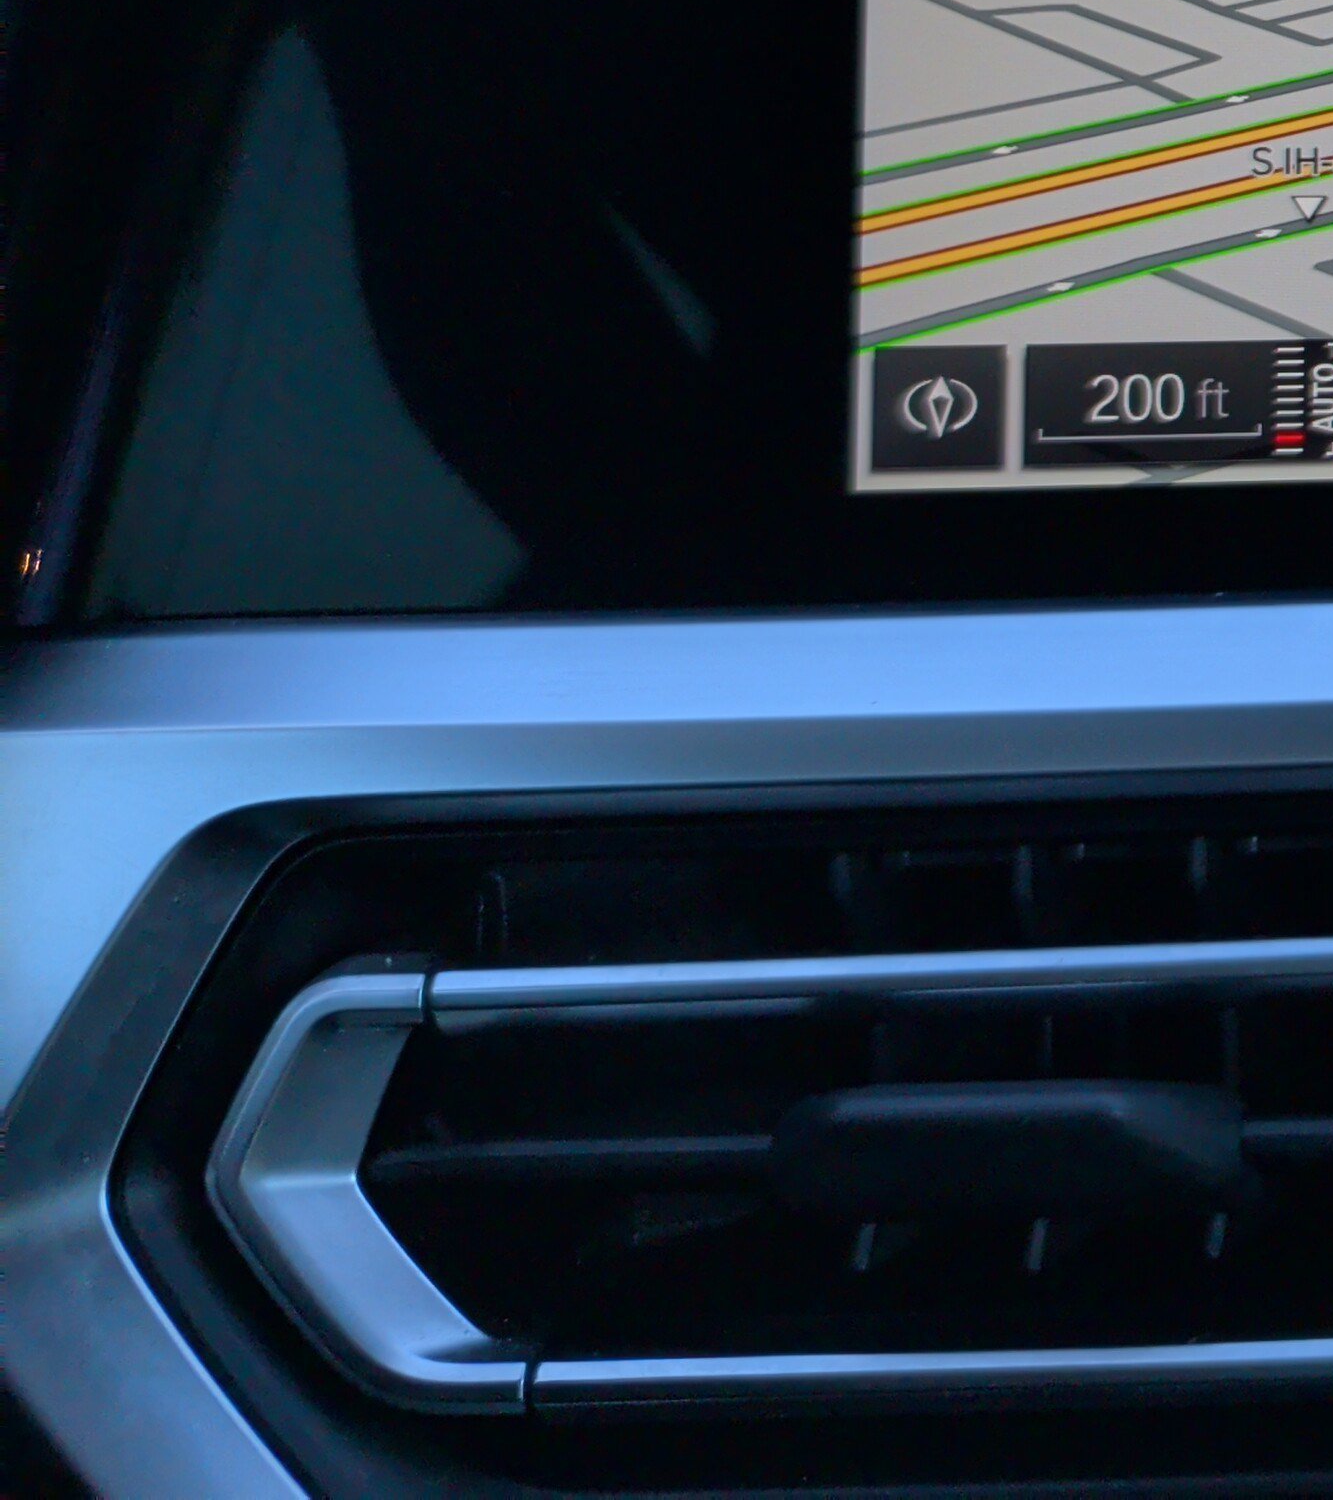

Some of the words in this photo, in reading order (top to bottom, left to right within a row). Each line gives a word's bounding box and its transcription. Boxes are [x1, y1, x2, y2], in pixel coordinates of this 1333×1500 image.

[1251, 149, 1272, 174] S
[1086, 373, 1184, 424] 200
[1196, 377, 1229, 418] ft
